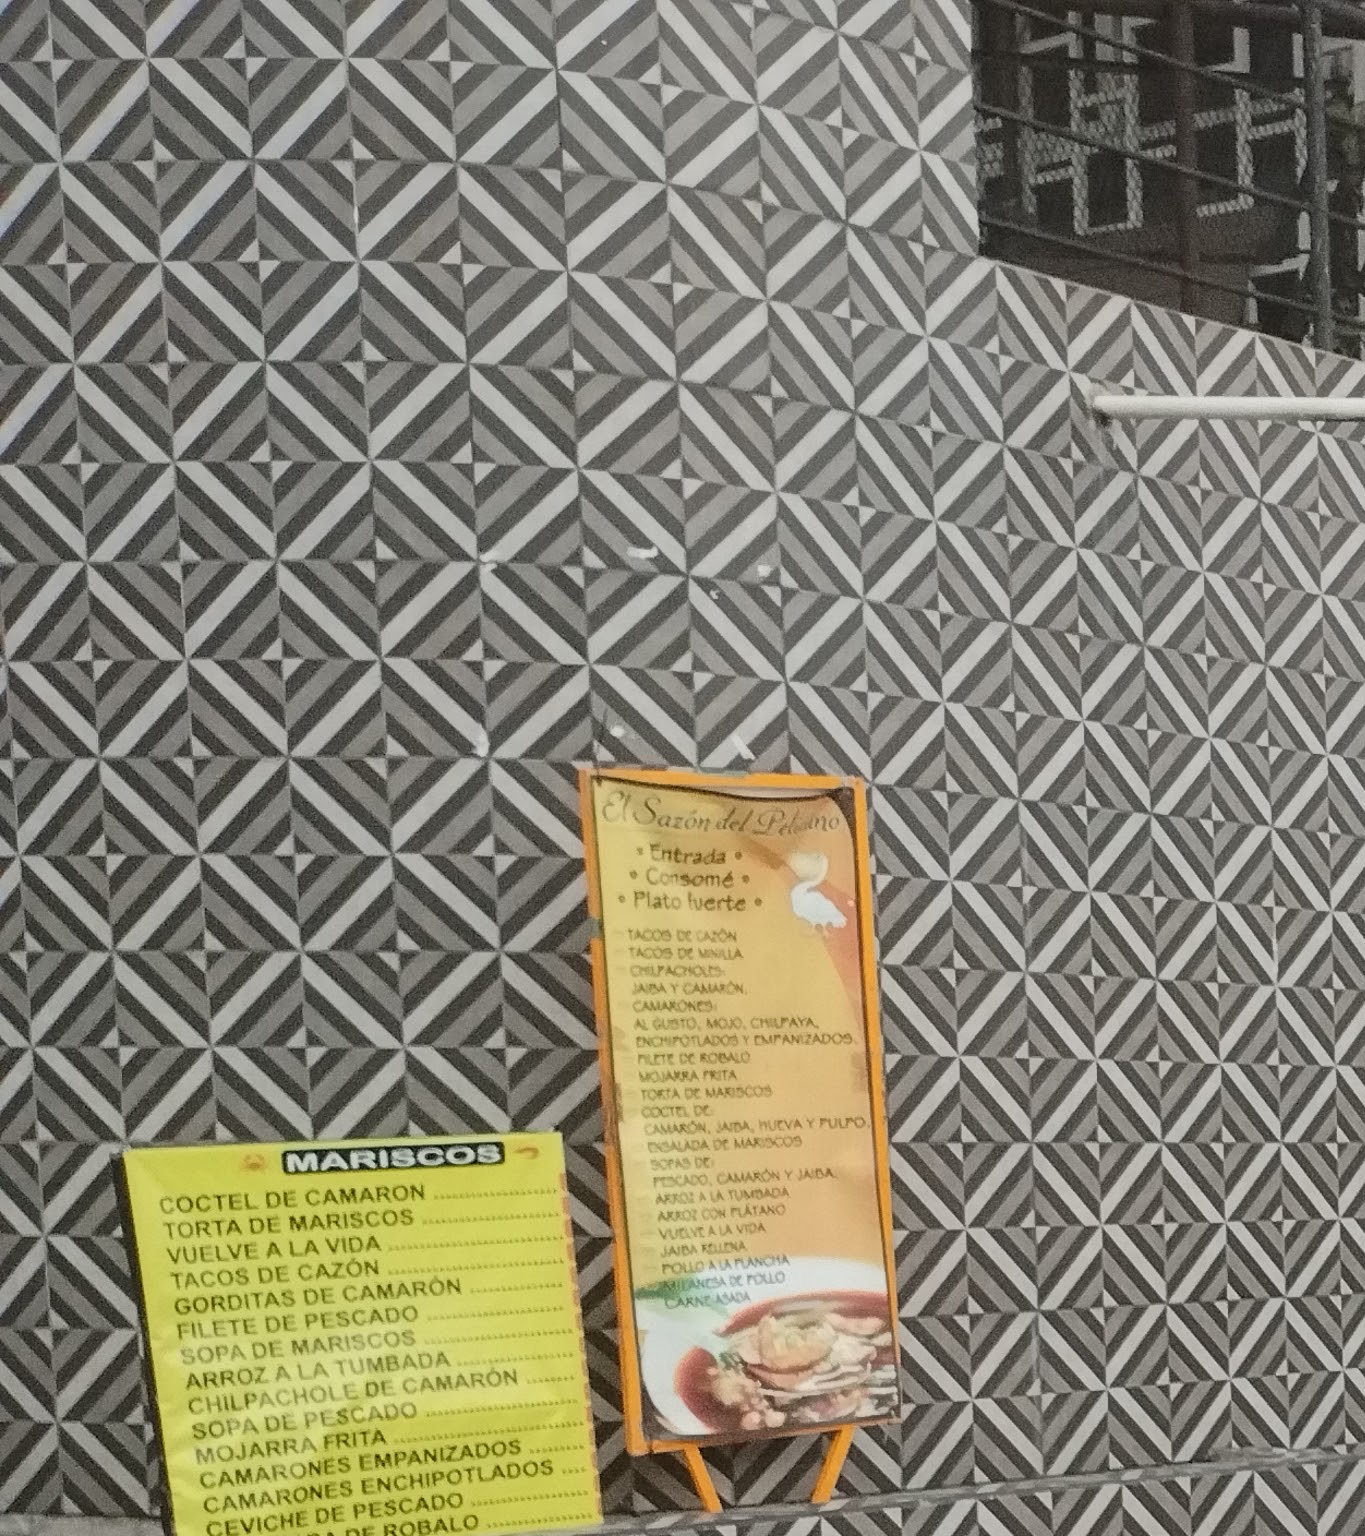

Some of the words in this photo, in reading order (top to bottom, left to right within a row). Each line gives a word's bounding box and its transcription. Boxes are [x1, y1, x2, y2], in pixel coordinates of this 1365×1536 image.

[602, 790, 632, 823] El
[633, 795, 713, 832] Sazón
[715, 807, 753, 832] del
[650, 844, 726, 865] Entrada
[646, 867, 735, 889] Consomé
[634, 890, 681, 910] Plato
[638, 1070, 699, 1083] MOJARRA
[702, 1069, 737, 1080] FRITA
[640, 1087, 681, 1101] TORTA
[684, 1087, 701, 1100] DE
[705, 1084, 773, 1099] MARISCOS
[286, 1144, 502, 1172] MARISCOS
[160, 1192, 259, 1214] COCTEL
[265, 1190, 298, 1209] DE
[305, 1185, 425, 1206] CAMARON
[162, 1219, 242, 1240] TORTA
[250, 1216, 281, 1235] DE
[289, 1209, 414, 1232] MARISCOS
[658, 1210, 697, 1223] ARROZ
[701, 1208, 726, 1220] CON
[658, 1227, 705, 1240] VUELVE
[708, 1225, 718, 1237] A
[718, 1224, 733, 1236] LA
[736, 1222, 767, 1234] VIDA
[167, 1242, 260, 1265] VUELVE
[266, 1241, 283, 1259] A
[289, 1240, 320, 1257] LA
[325, 1235, 381, 1256] VIDA
[662, 1261, 704, 1275] POLLO
[707, 1259, 718, 1271] A
[719, 1259, 733, 1271] LA
[734, 1254, 791, 1269] PLANCHA
[170, 1267, 249, 1290] TACOS
[257, 1265, 290, 1284] DE
[298, 1258, 380, 1281] CAZÓN
[174, 1288, 296, 1315] GORDITAS
[303, 1287, 336, 1306] DE
[342, 1276, 462, 1302] CAMARÓN
[177, 1317, 257, 1340] FILETE
[265, 1315, 298, 1333] DE
[305, 1305, 419, 1329] PESCADO
[181, 1343, 247, 1366] SOPA
[252, 1340, 285, 1360] DE
[291, 1329, 416, 1355] MARISCOS
[186, 1366, 271, 1391] ARROZ
[275, 1365, 291, 1382] A
[298, 1361, 329, 1381] LA
[336, 1351, 451, 1377] TUMBADA
[188, 1384, 358, 1415] CHILPACHOLE
[365, 1379, 397, 1398] DE
[402, 1367, 519, 1395] CAMARÓN
[192, 1417, 259, 1440] SOPA
[264, 1414, 298, 1433] DE
[304, 1402, 417, 1429] PESCADO
[195, 1437, 318, 1465] MOJARRA
[323, 1429, 387, 1449] FRITA
[200, 1456, 351, 1490] CAMARONES
[359, 1440, 522, 1472] EMPANIZADOS
[203, 1480, 353, 1515] CAMARONES
[361, 1459, 554, 1495] ENCHIPOTLADOS
[315, 1505, 346, 1525] DE
[353, 1492, 464, 1520] PESCADO
